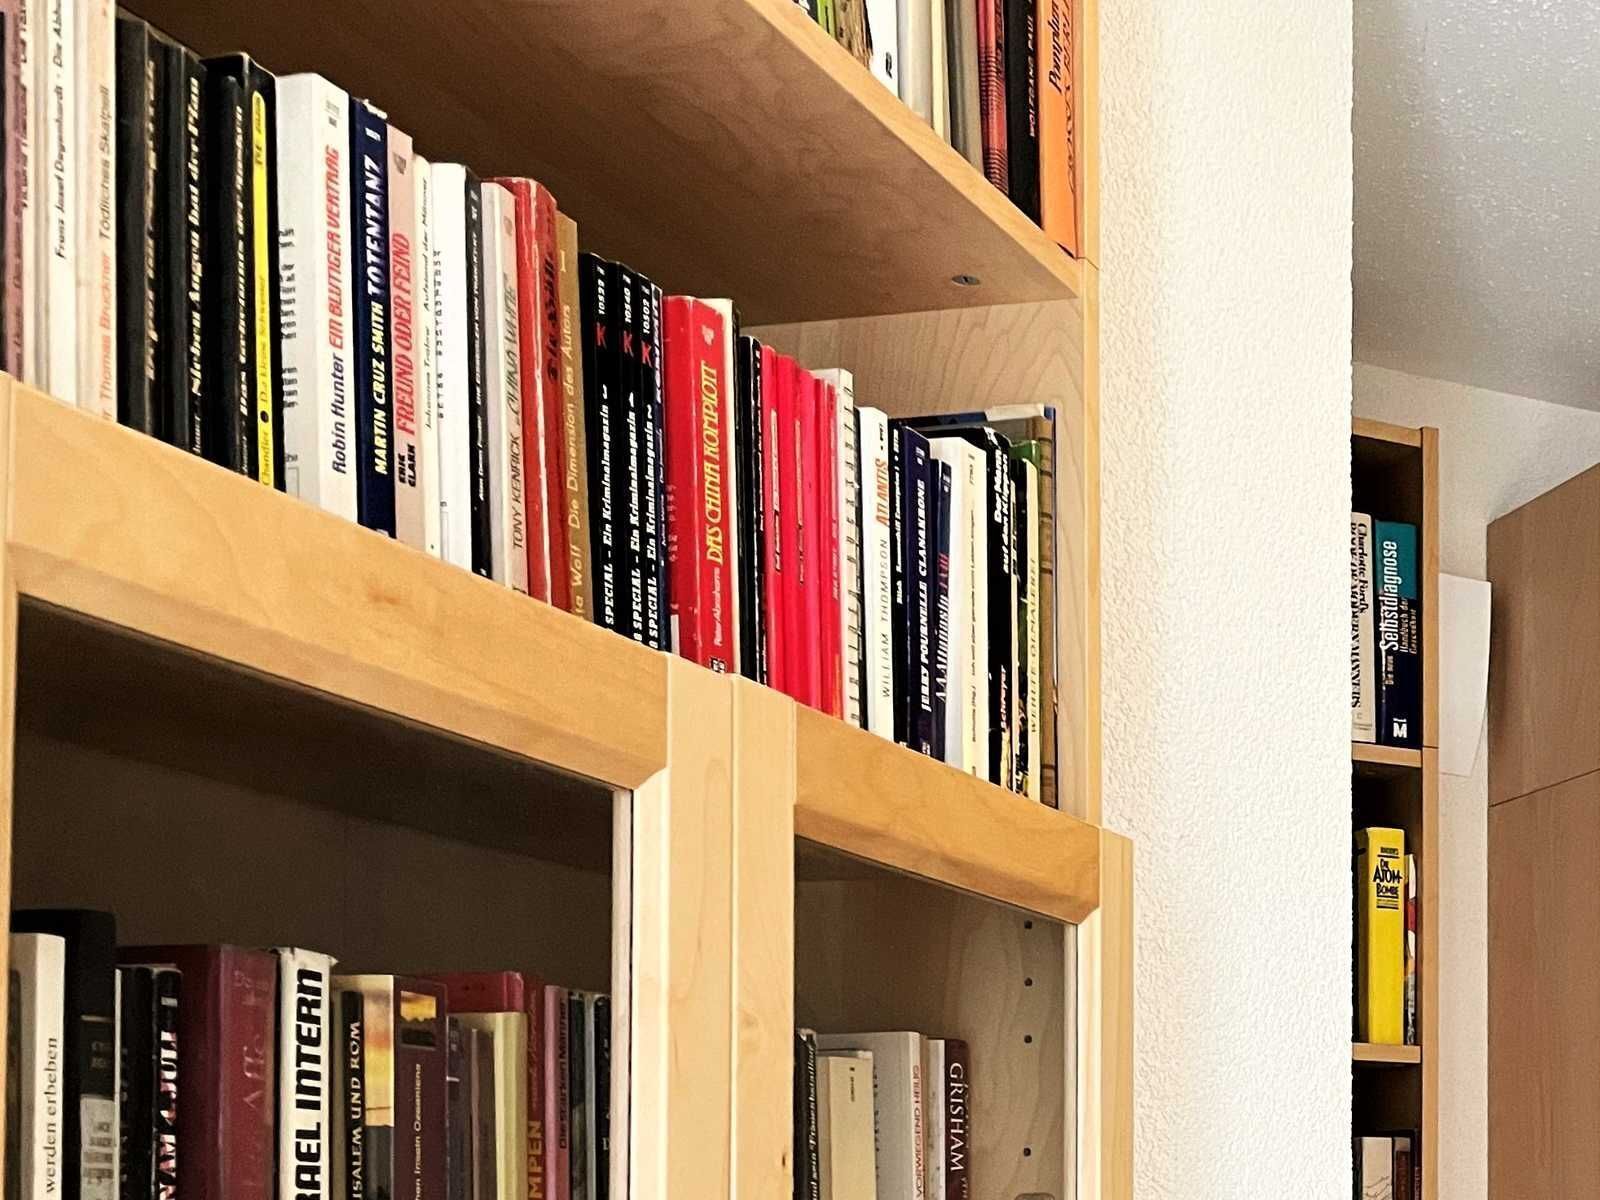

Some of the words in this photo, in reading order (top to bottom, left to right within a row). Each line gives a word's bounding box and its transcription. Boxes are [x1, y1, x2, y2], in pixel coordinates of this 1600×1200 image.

[324, 144, 341, 229] VERTRAG
[54, 217, 67, 259] Franz
[363, 153, 386, 296] TOTENTANZ
[326, 232, 343, 317] BLUTIGER
[390, 232, 411, 296] FEIND
[328, 319, 344, 350] EIN
[370, 300, 385, 355] SMITH
[392, 297, 413, 351] ODER
[559, 305, 573, 357] Autors
[98, 335, 113, 402] Thomas
[331, 352, 346, 418] Hunter
[371, 360, 387, 405] CRUZ
[393, 353, 416, 436] FREUND
[562, 366, 576, 396] des
[700, 359, 721, 459] KOMPLOTT
[332, 420, 347, 474] Robin
[372, 409, 389, 475] MARTIN
[509, 432, 522, 505] KENRICK
[563, 403, 579, 492] Dimension
[600, 404, 612, 520] Kriminalmagazin
[627, 410, 639, 526] Kriminalmagazin
[644, 420, 656, 535] Kriminalmagazin
[703, 461, 723, 523] CHINA
[874, 456, 890, 527] ATLANTIS
[510, 507, 523, 550] TONY
[566, 499, 581, 529] Die
[602, 522, 613, 547] Ein
[629, 527, 640, 551] Ein
[704, 525, 725, 564] DAS
[570, 544, 585, 587] Wolf
[646, 536, 656, 560] Ein
[1357, 522, 1368, 579] Charlotte
[603, 563, 615, 625] SPECIAL
[631, 567, 643, 630] SPECIAL
[647, 575, 658, 638] SPECIAL
[879, 538, 890, 623] THOMPSON
[1378, 541, 1403, 651] Selbstdiagnose
[919, 581, 931, 664] POURNELLE
[1399, 607, 1409, 653] Handbuch
[881, 632, 891, 699] WILLIAM
[920, 666, 933, 711] JERRY
[158, 1031, 178, 1100] JULI
[294, 968, 323, 1111] INTERN
[349, 1021, 362, 1070] ROM
[350, 1077, 362, 1120] UND
[949, 1062, 965, 1172] GRISHAM
[42, 1121, 57, 1195] werden
[158, 1134, 177, 1178] AM
